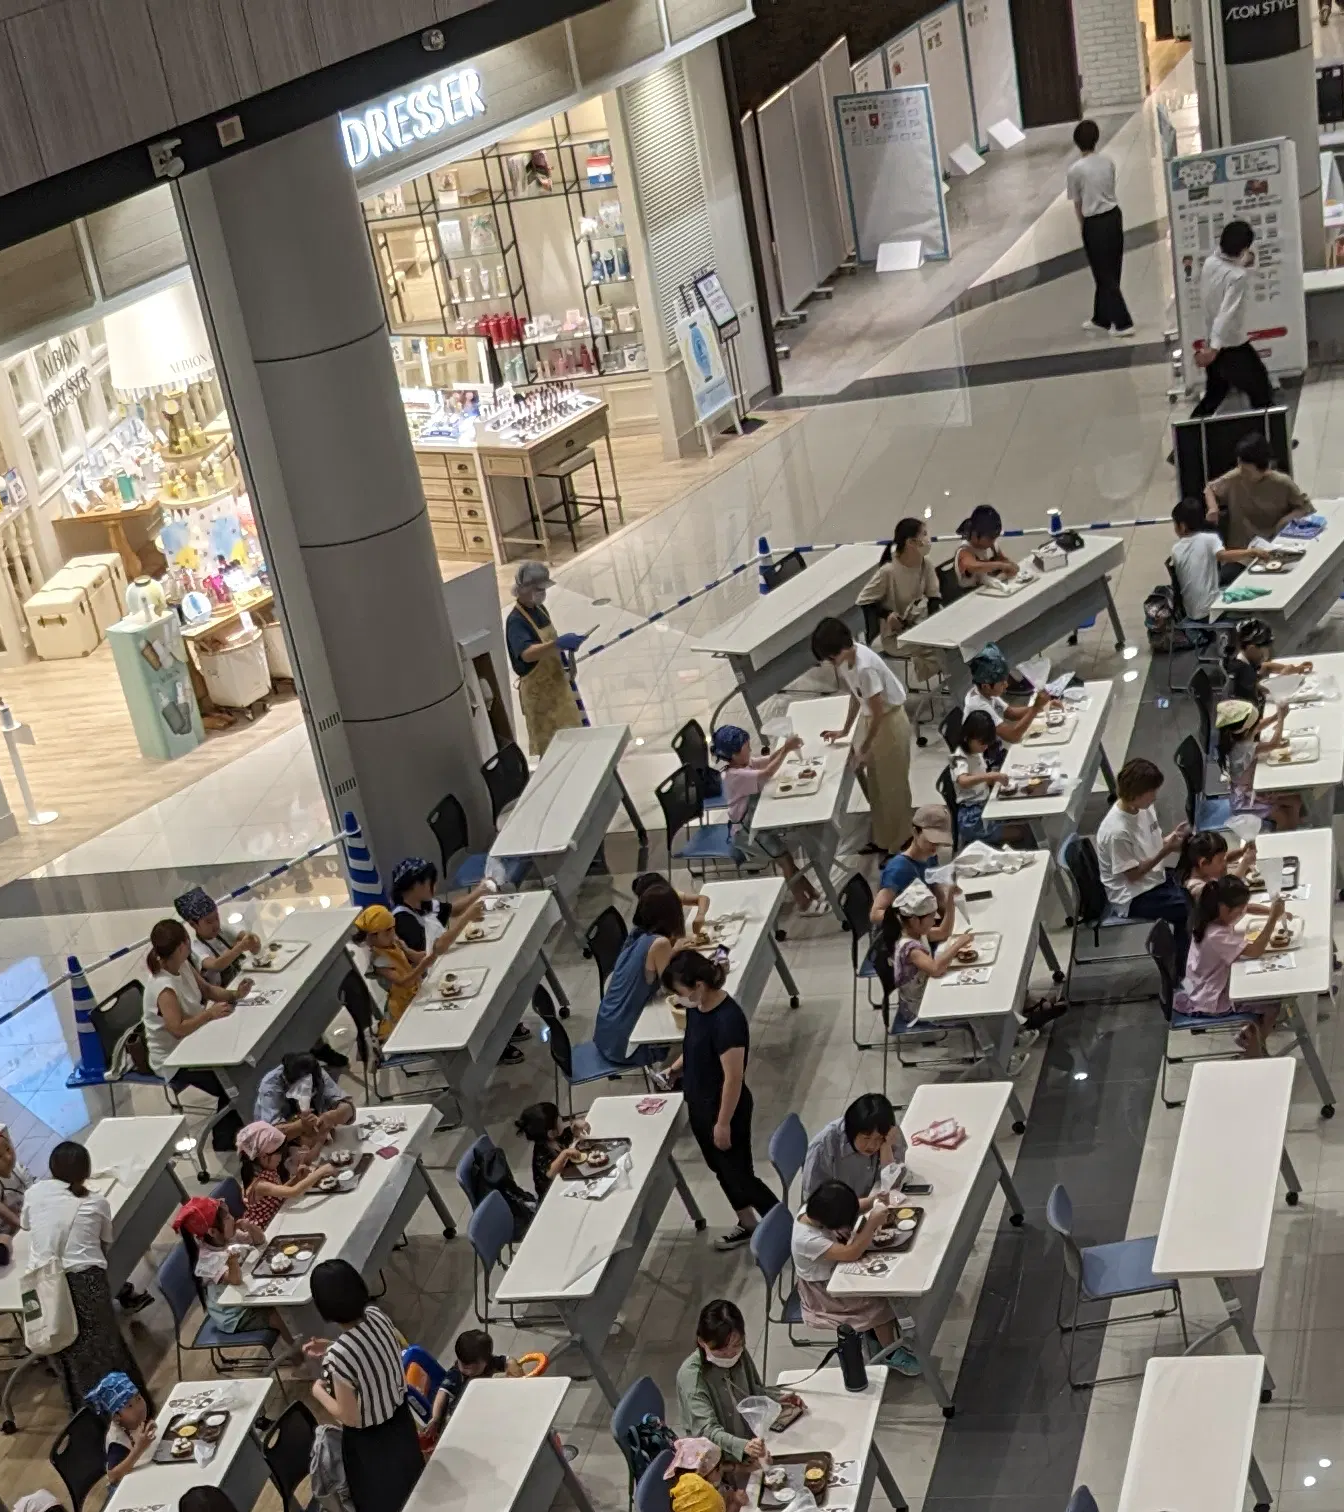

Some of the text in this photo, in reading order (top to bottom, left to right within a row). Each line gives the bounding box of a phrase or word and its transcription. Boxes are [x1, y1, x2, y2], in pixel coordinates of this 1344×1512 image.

[339, 68, 486, 168] DRESSER
[42, 334, 81, 379] ALBION
[169, 352, 208, 374] ALBION
[47, 365, 92, 417] DRESSER
